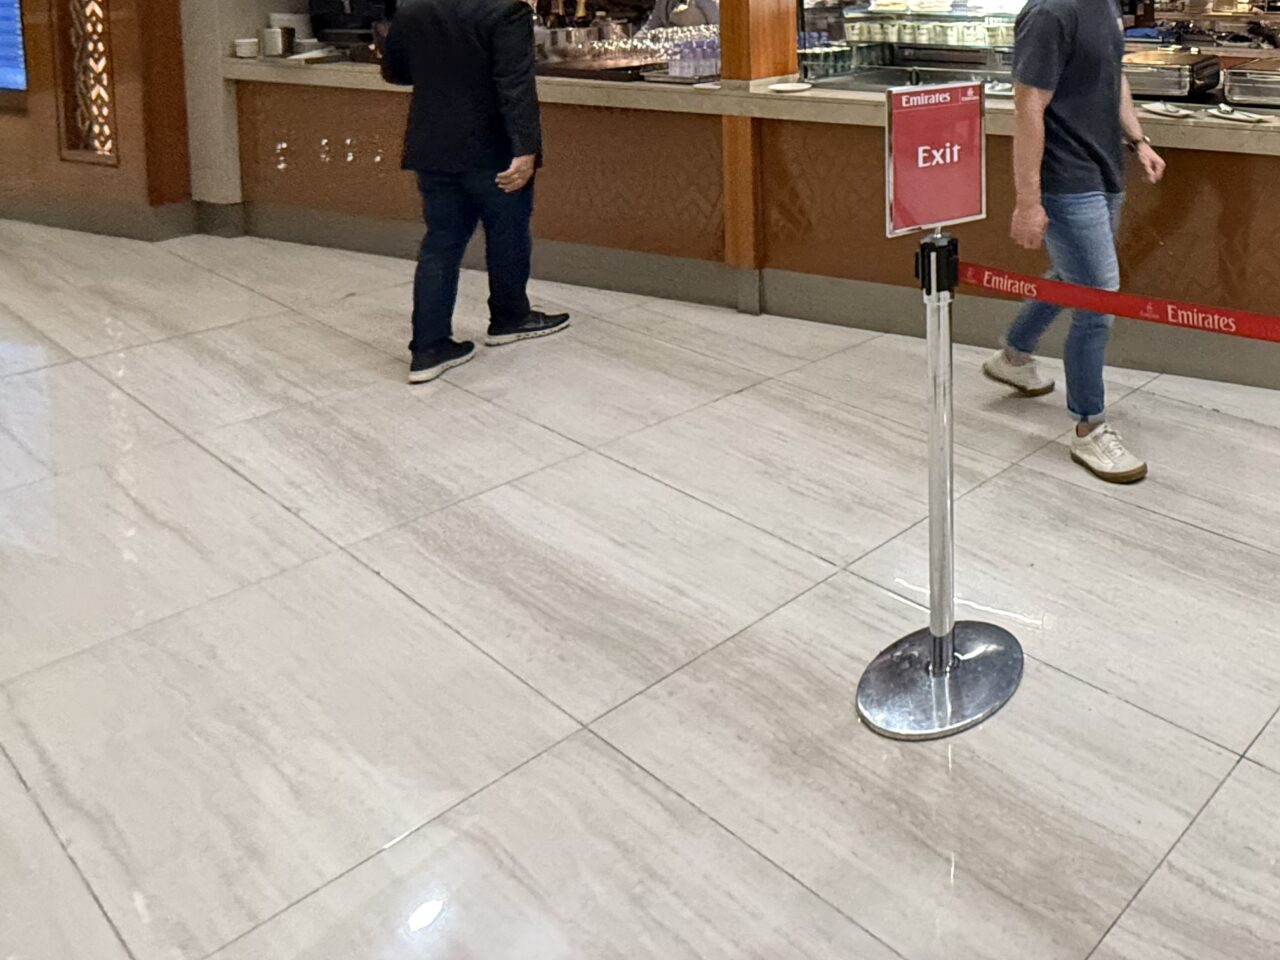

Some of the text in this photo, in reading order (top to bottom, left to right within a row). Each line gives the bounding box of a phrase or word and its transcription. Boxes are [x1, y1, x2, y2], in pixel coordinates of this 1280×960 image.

[901, 92, 951, 108] Emirates
[917, 142, 961, 168] Exit
[983, 270, 1038, 298] Emirates
[1167, 304, 1237, 333] Emirates
